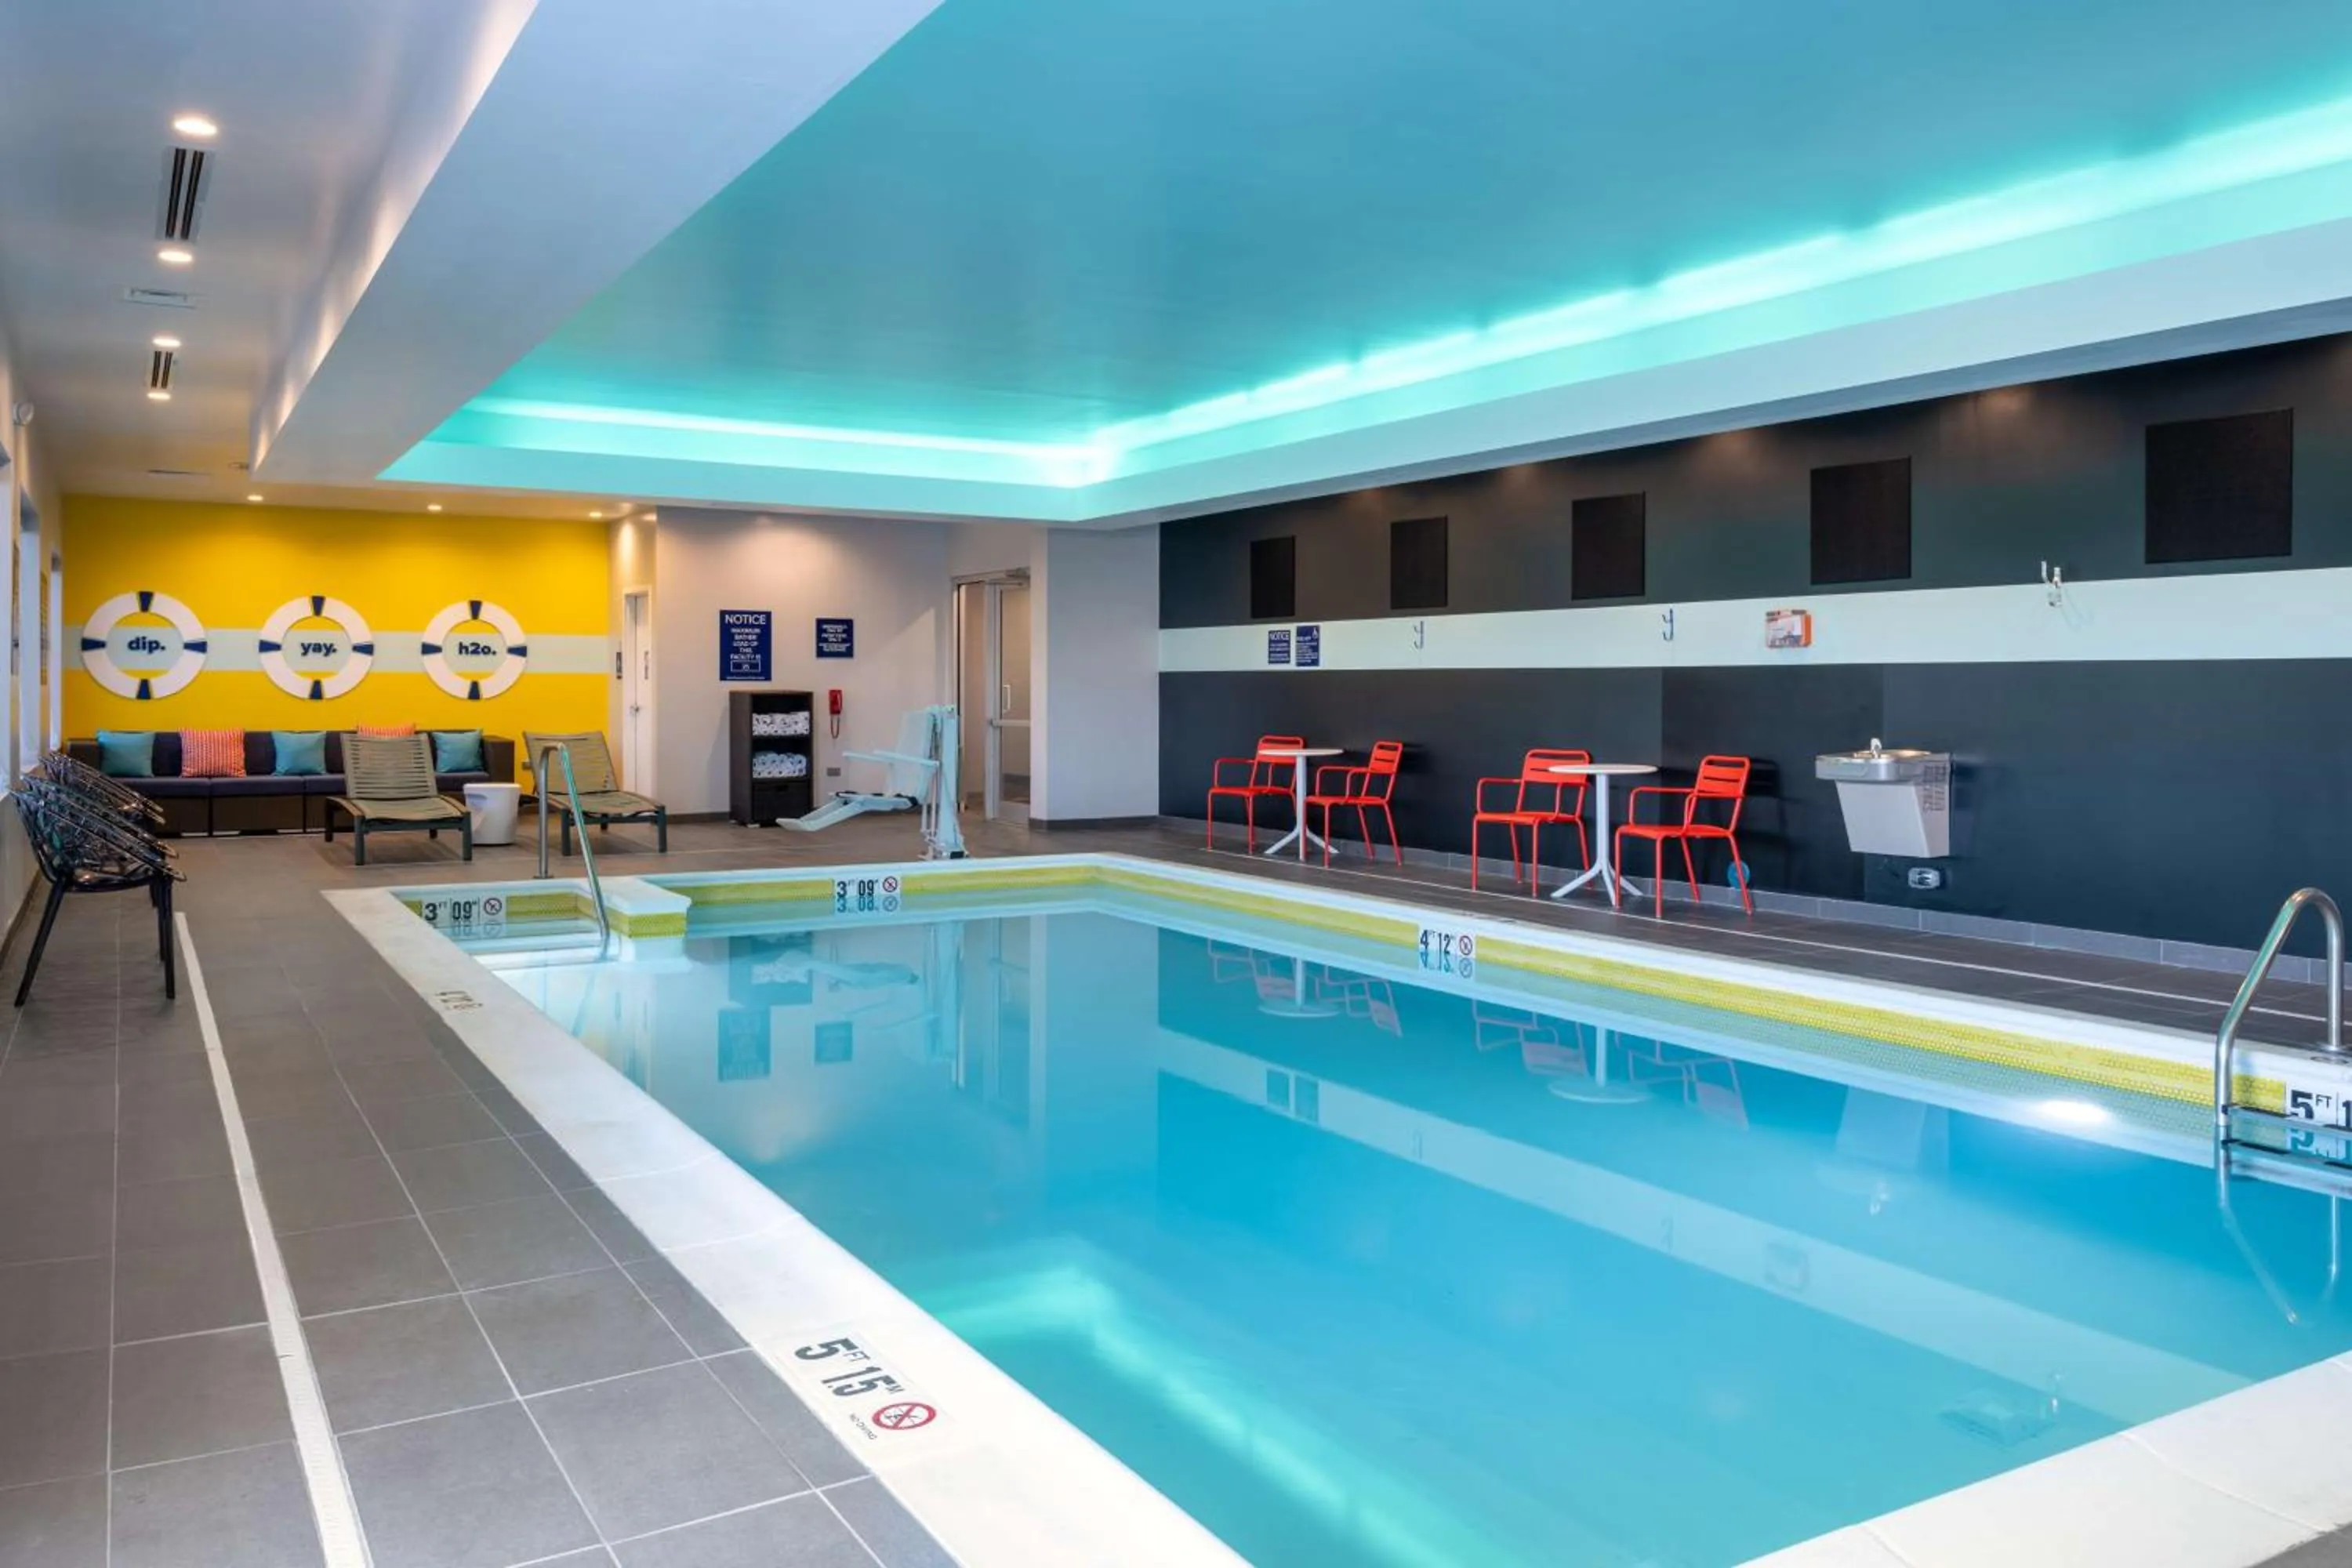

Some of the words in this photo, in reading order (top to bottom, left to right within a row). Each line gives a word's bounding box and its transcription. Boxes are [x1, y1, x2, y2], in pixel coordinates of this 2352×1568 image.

[725, 614, 766, 625] NOTICE
[127, 636, 166, 655] dip.
[300, 642, 337, 657] yay.
[459, 641, 497, 655] h2o.
